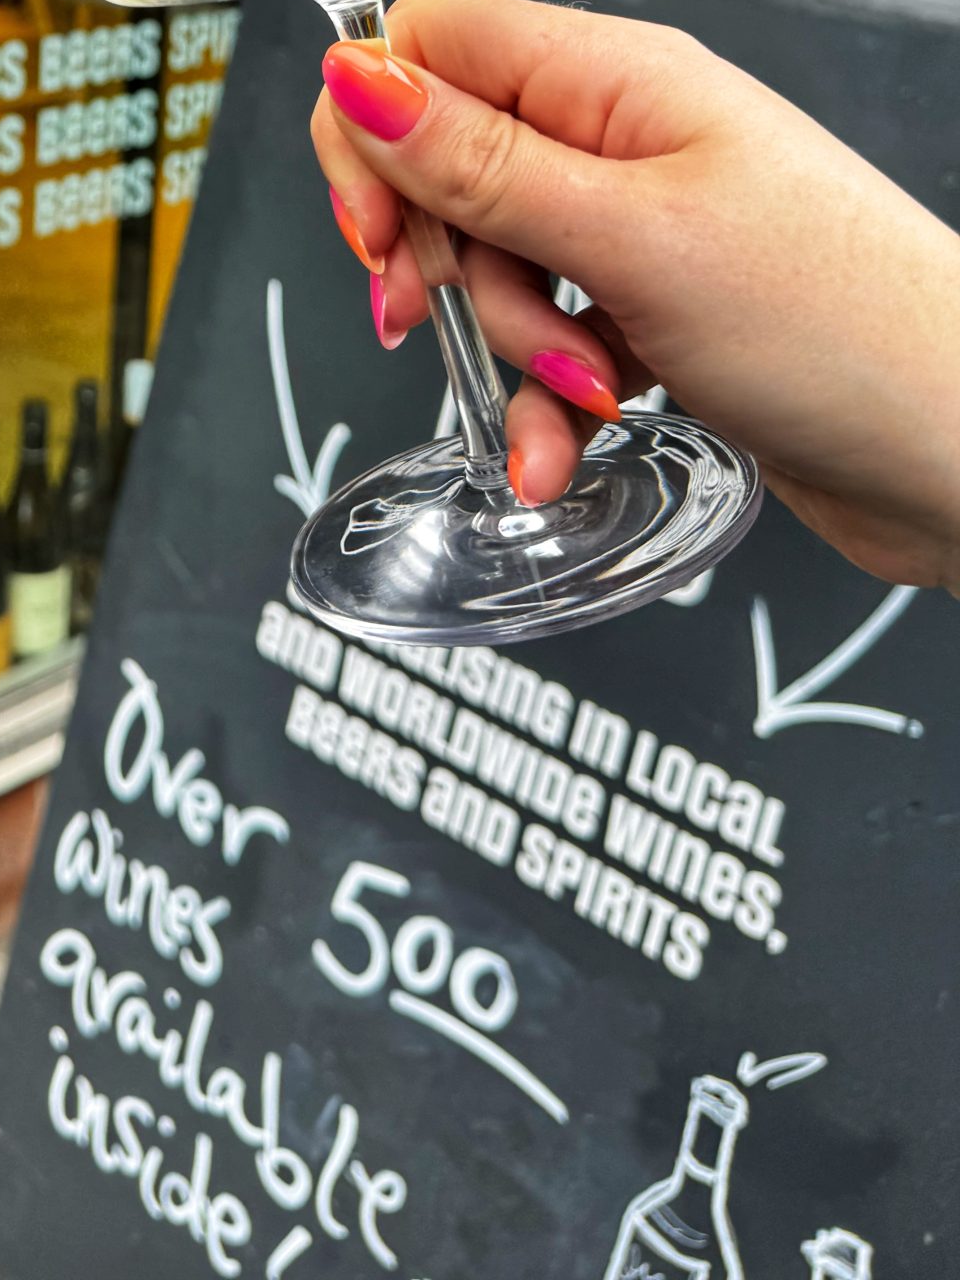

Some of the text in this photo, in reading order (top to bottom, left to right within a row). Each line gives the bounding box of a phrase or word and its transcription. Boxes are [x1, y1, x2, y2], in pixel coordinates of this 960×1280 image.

[104, 657, 290, 865] Over
[311, 858, 518, 1032] 500
[515, 822, 711, 981] SPIRITS
[40, 927, 407, 1271] available
